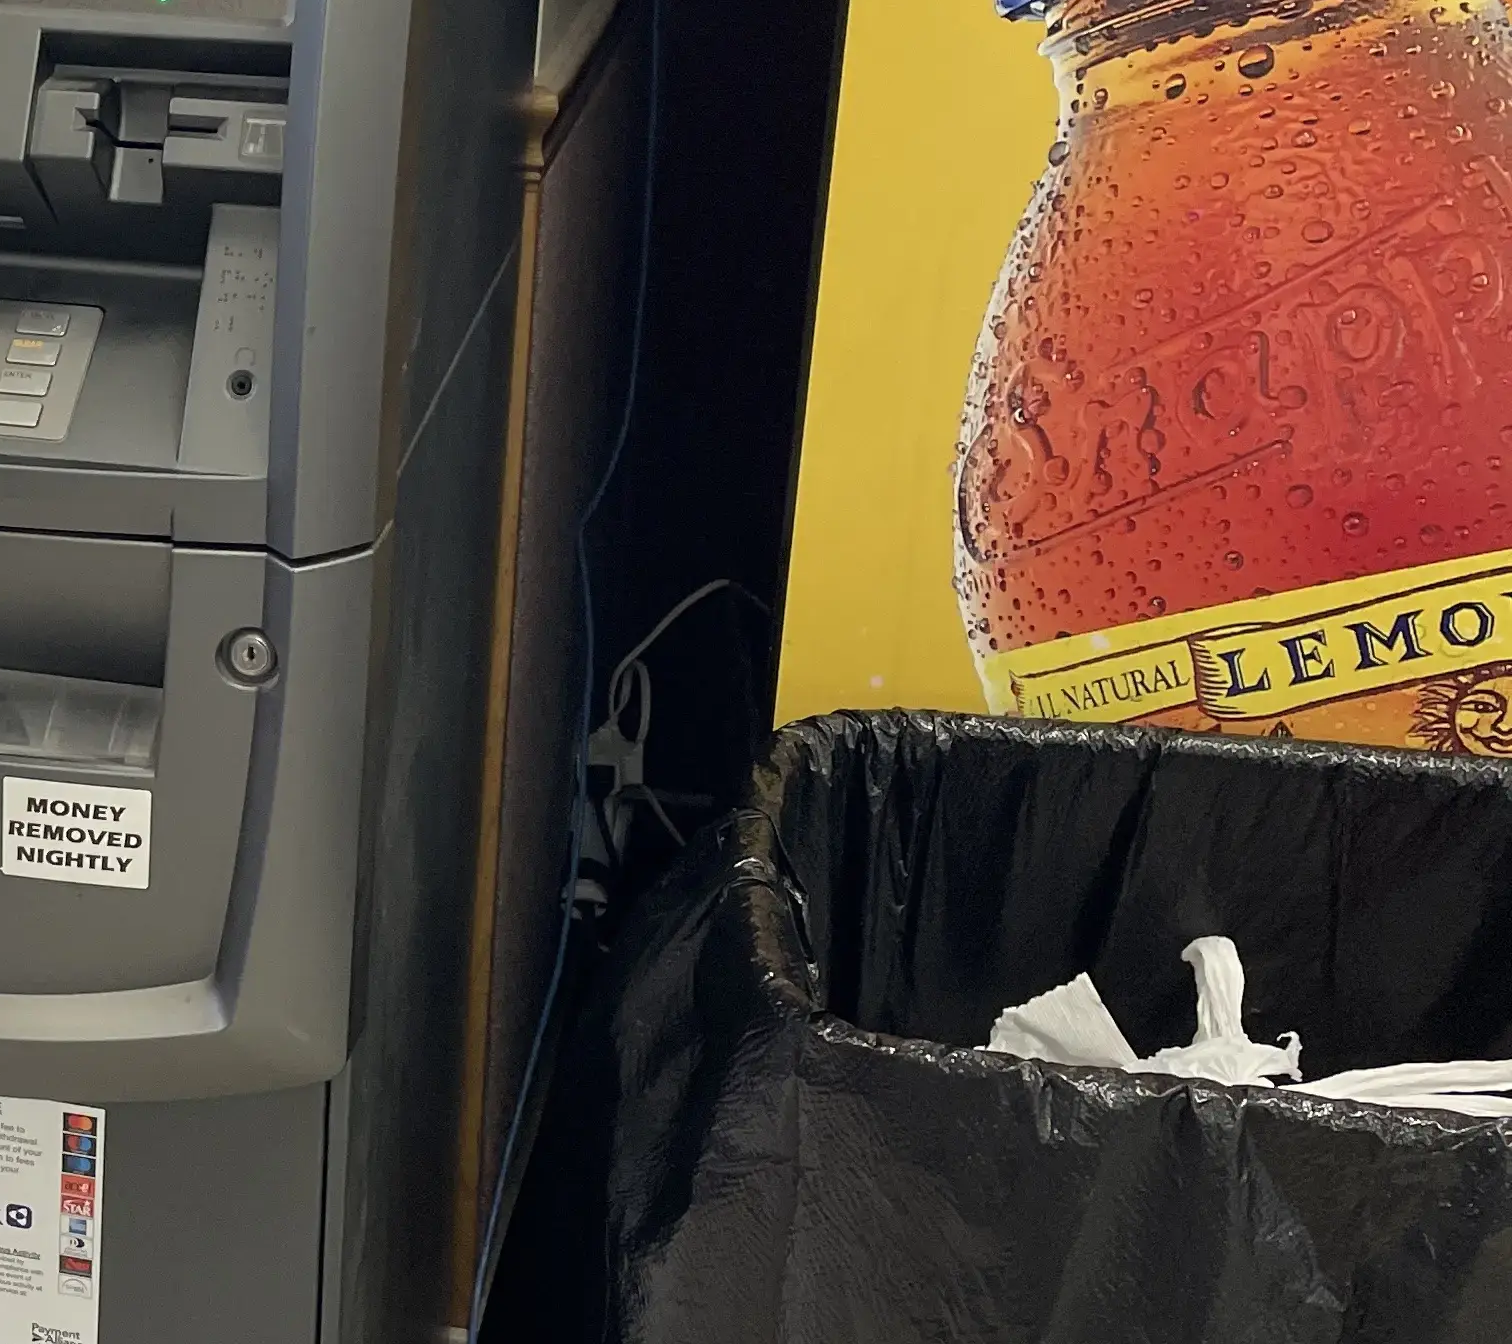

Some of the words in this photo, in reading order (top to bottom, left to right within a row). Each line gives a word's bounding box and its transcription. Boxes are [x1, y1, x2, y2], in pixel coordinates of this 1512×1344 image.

[1217, 591, 1512, 698] LEMO
[1060, 660, 1191, 712] NATURAL
[26, 797, 126, 822] MONEY
[8, 820, 143, 849] REMOVED
[16, 846, 133, 873] NIGHTLY
[63, 1202, 92, 1217] STAR
[32, 1322, 81, 1340] Payment
